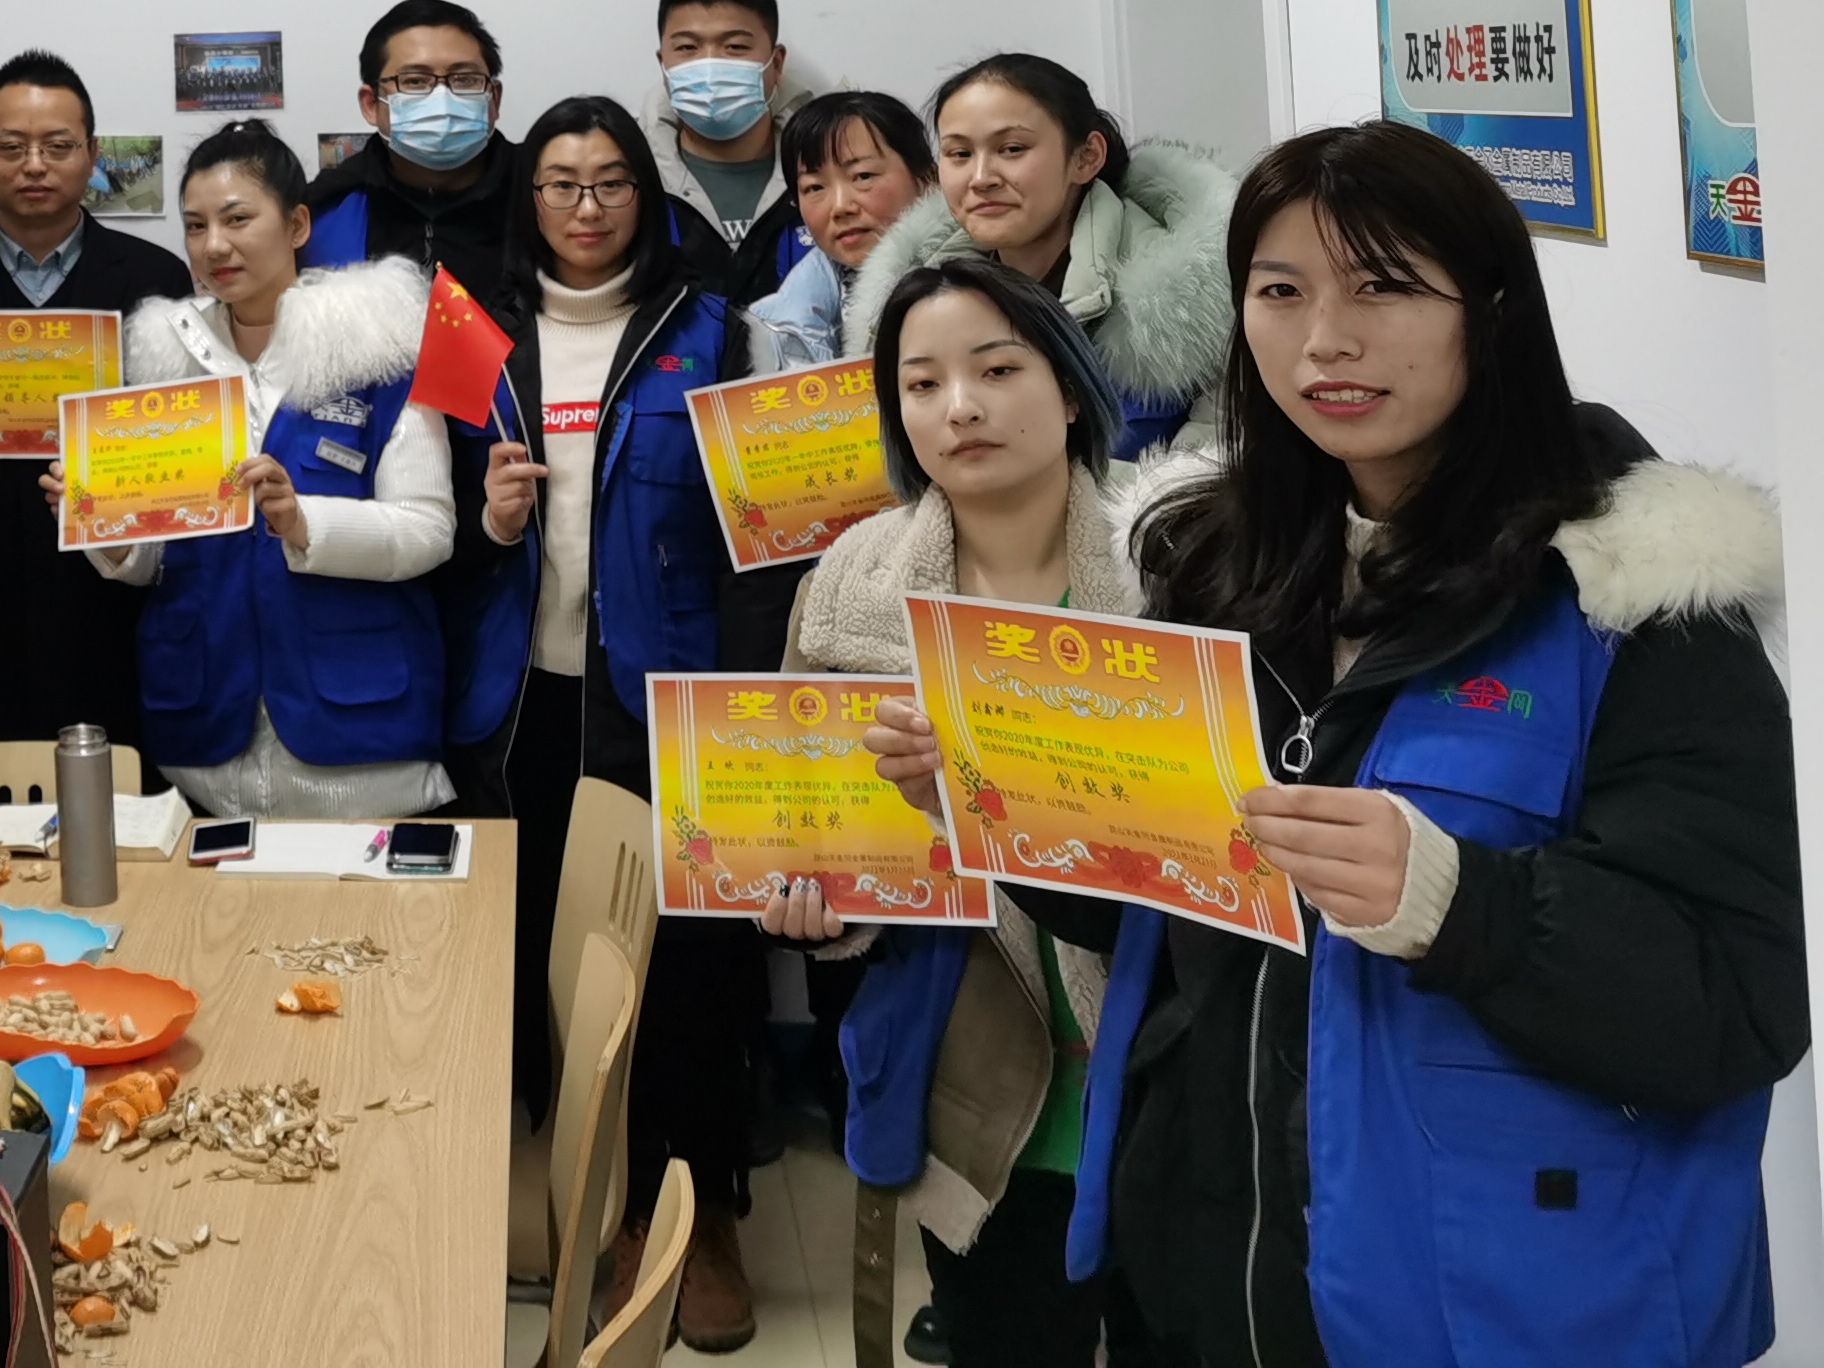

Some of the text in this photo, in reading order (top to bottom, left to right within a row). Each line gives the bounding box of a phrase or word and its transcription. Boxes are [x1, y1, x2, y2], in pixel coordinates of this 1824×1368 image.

[1405, 22, 1556, 83] 及时处理要做好
[542, 407, 599, 430] Supre
